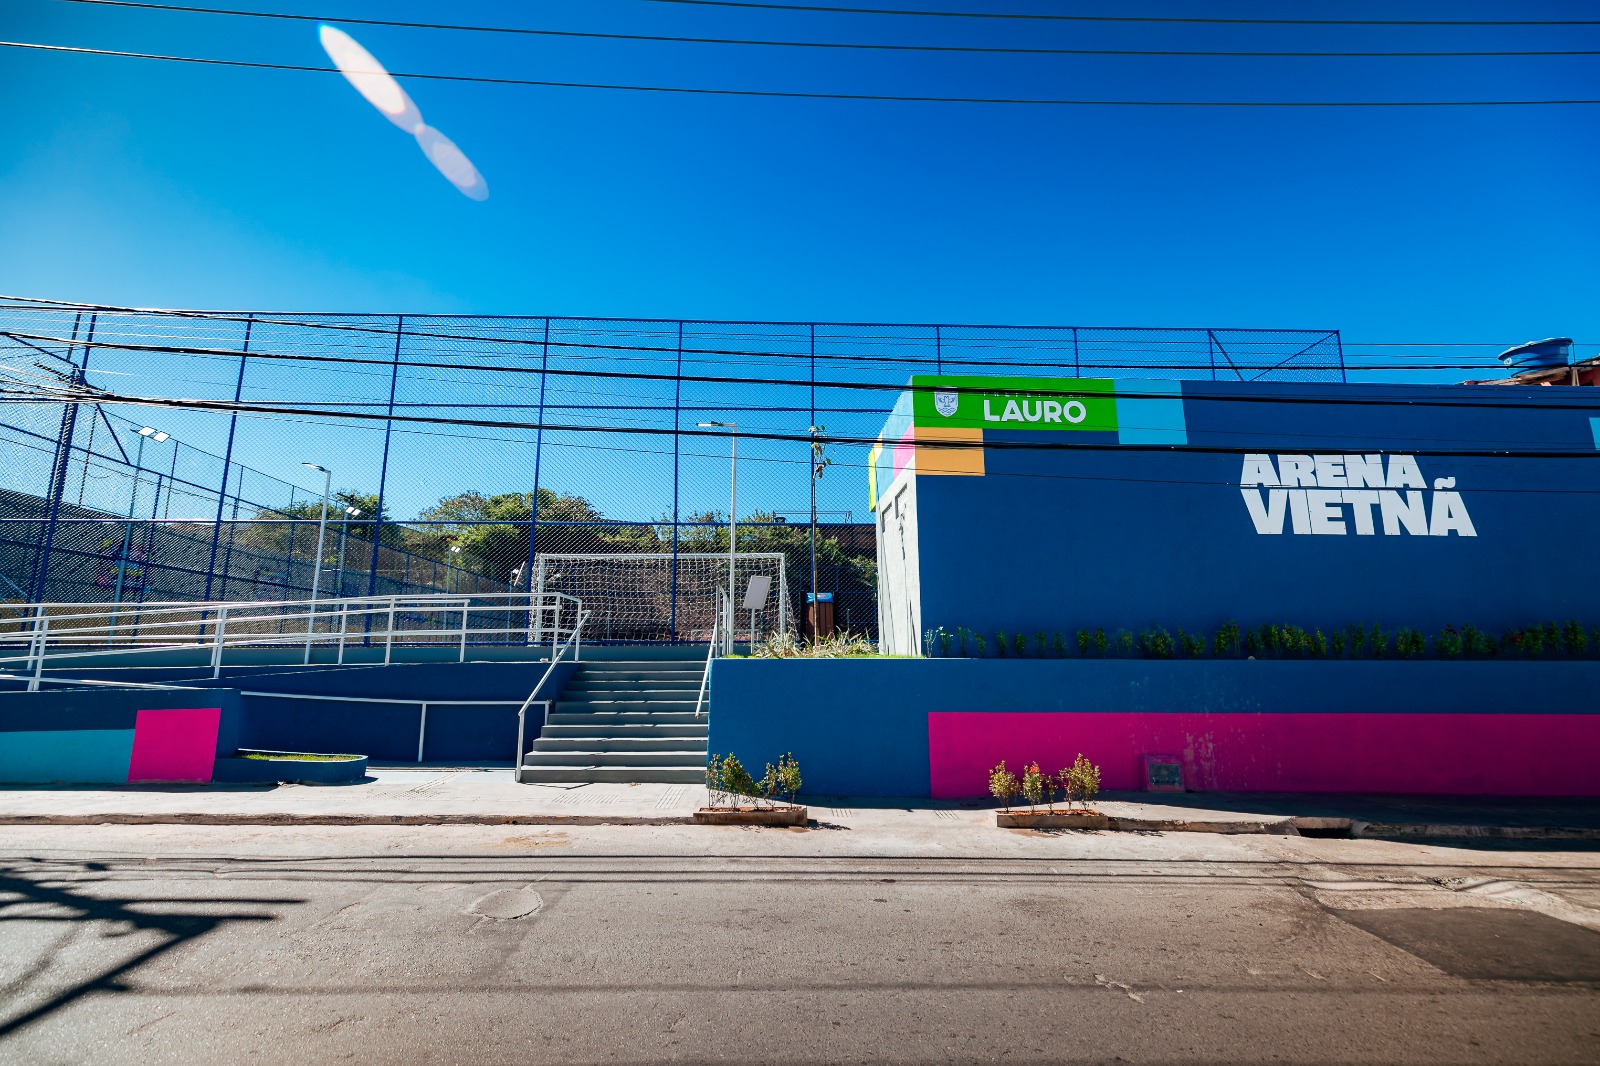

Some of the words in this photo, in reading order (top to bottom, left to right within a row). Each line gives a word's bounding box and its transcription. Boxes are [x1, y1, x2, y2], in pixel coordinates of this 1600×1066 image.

[983, 399, 1087, 424] LAURO
[1240, 453, 1428, 489] ARENA
[1240, 476, 1478, 537] VIETNÃ
